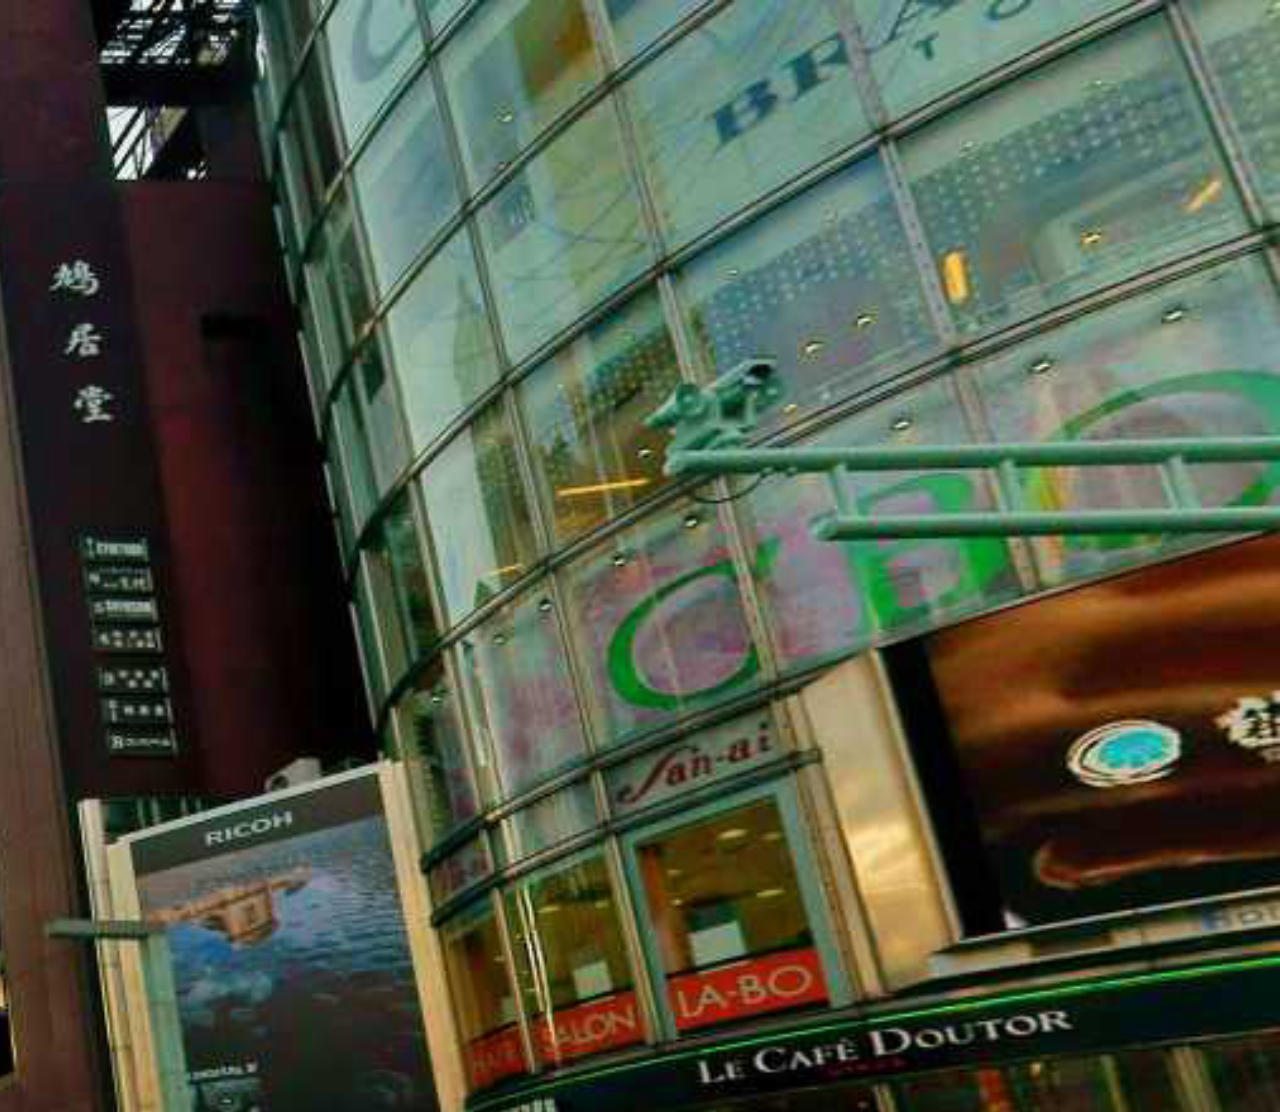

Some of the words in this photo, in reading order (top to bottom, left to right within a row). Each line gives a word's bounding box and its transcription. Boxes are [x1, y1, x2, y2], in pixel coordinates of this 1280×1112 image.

[48, 259, 115, 423] 鳩居堂
[205, 810, 294, 847] RICOH
[677, 965, 813, 1018] LA-BO
[867, 1008, 1074, 1058] DOUTOR
